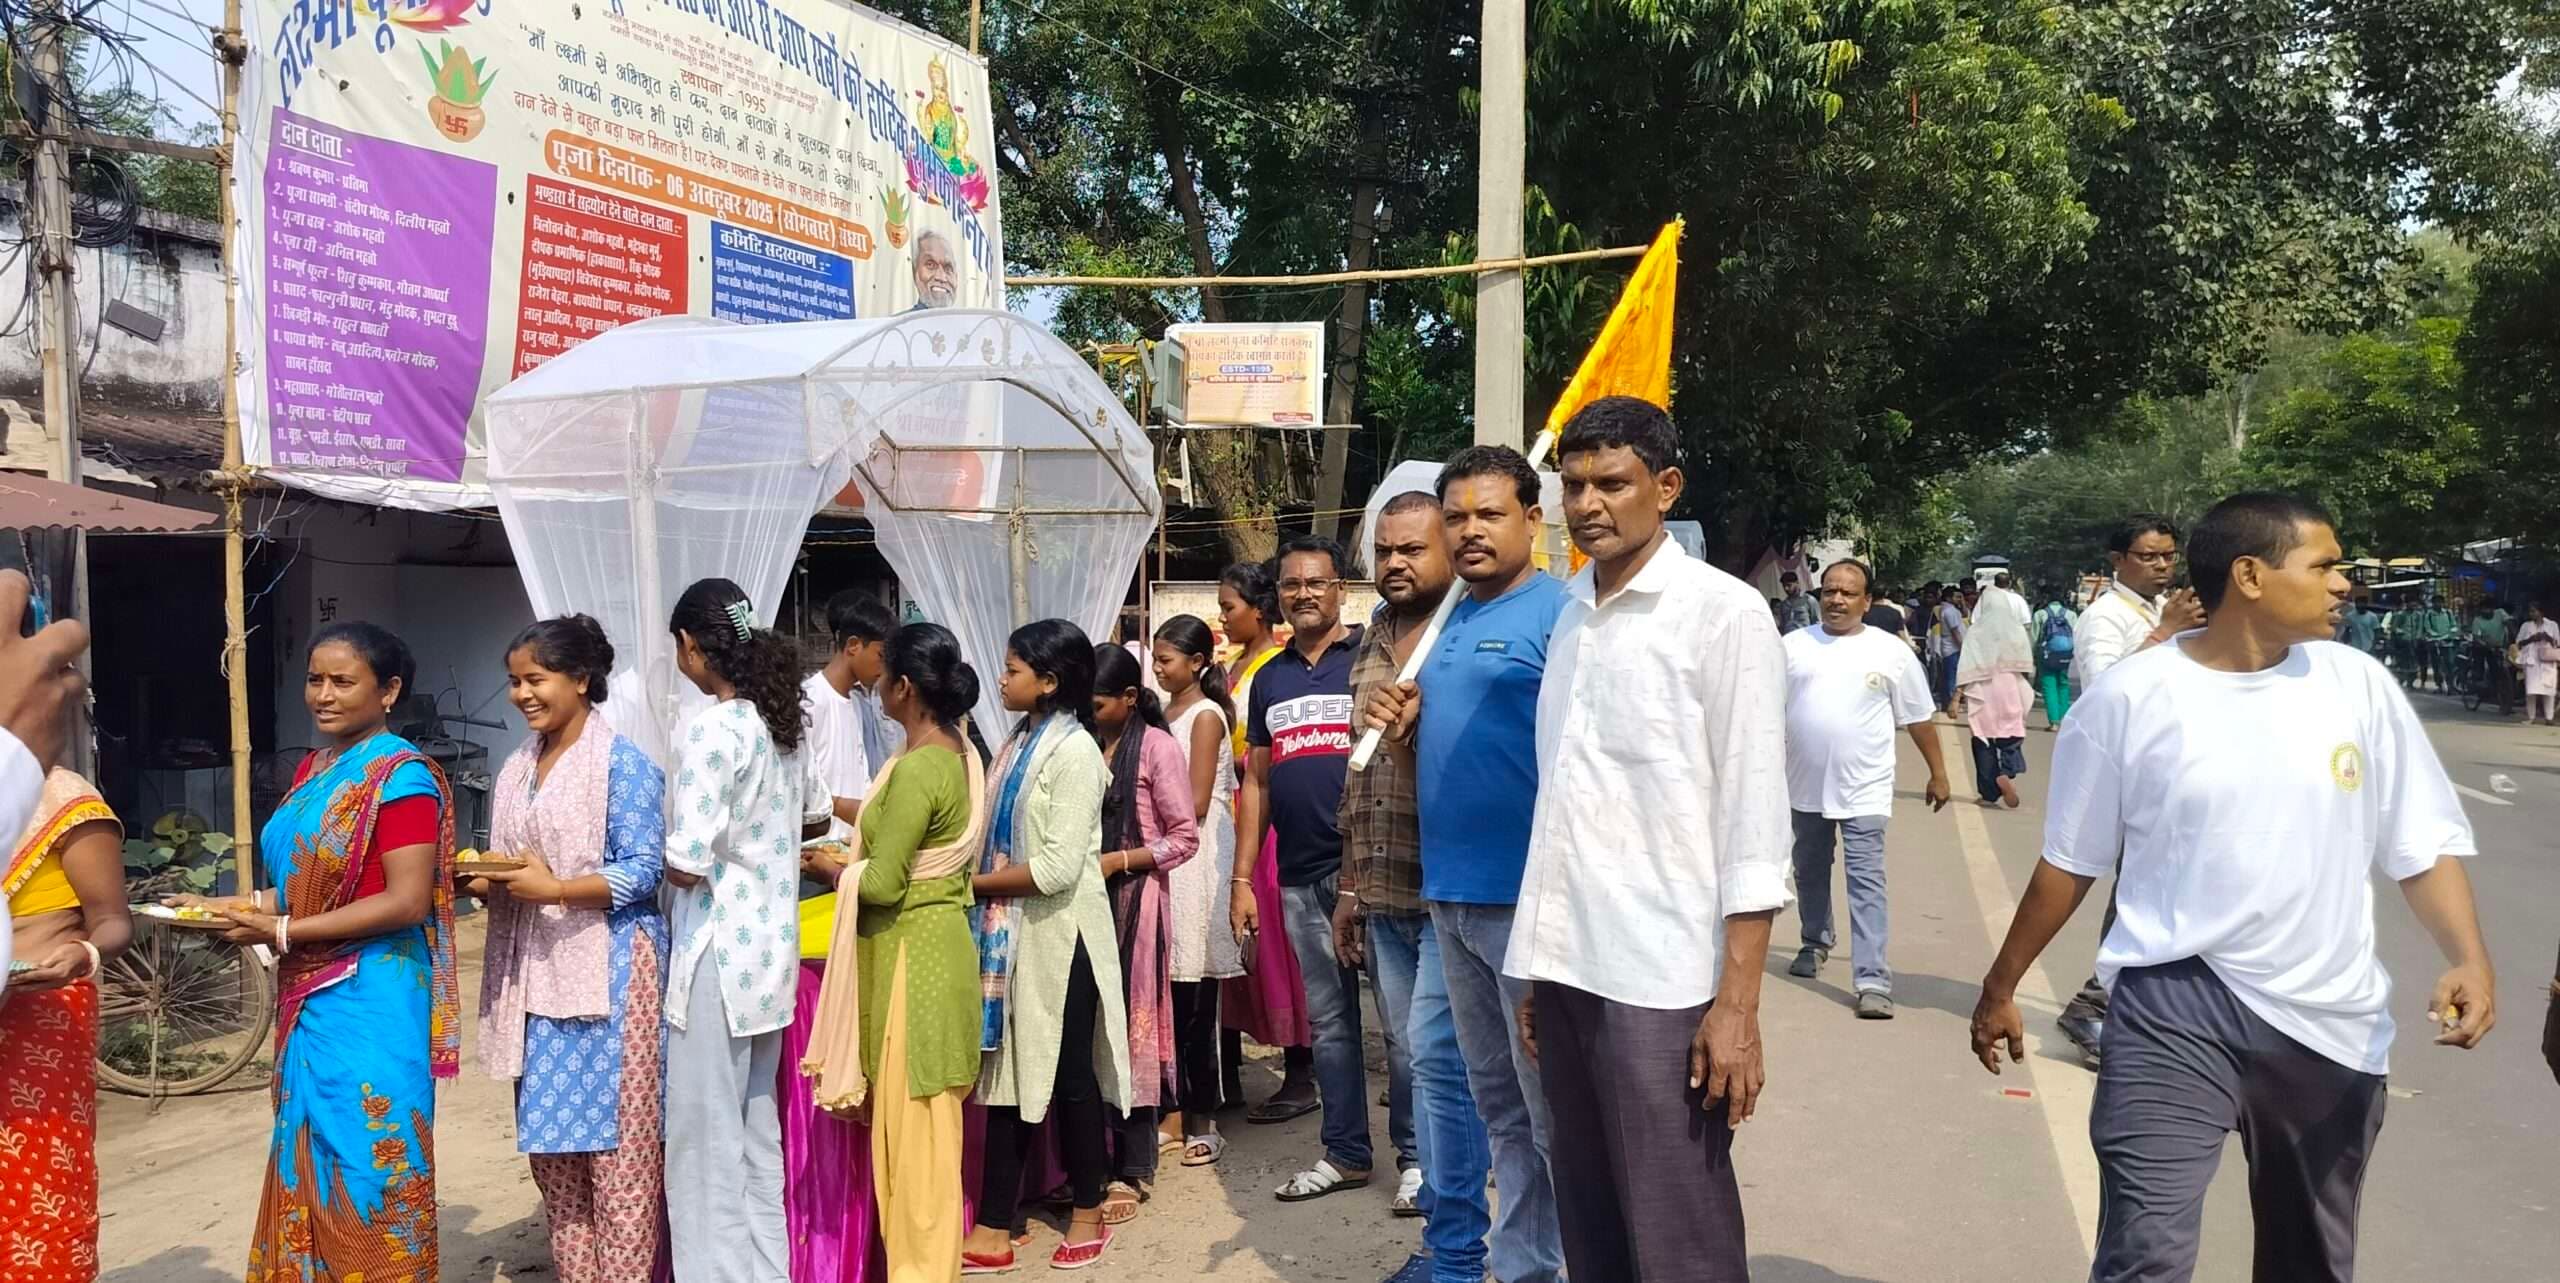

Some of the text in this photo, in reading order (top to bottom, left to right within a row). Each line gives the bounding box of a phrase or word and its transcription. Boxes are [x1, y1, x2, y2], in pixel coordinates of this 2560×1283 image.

[558, 73, 602, 104] आपकी
[609, 92, 643, 119] मुराद
[650, 104, 665, 127] भी
[616, 62, 661, 98] अभिभूत
[669, 80, 681, 102] हो
[680, 68, 723, 96] स्थापना
[738, 90, 766, 114] 1995
[774, 8, 811, 77] आप
[842, 50, 863, 120] को
[864, 78, 908, 161] हार्दिक
[281, 120, 307, 148] दान
[311, 127, 343, 159] दाता
[513, 90, 537, 111] दान
[577, 111, 601, 137] बहुत
[627, 127, 646, 147] फल
[647, 129, 678, 157] मिलता
[694, 149, 708, 168] पर
[276, 157, 286, 172] 1.
[272, 181, 284, 196] 2.
[287, 185, 307, 204] पूजा
[395, 209, 426, 230] दिलीप
[427, 218, 450, 236] महतो
[535, 184, 674, 233] भण्डारा में सहयोग देने वाले दान दाता
[552, 139, 593, 177] पूजा
[666, 173, 685, 199] 06
[688, 180, 742, 220] अक्टूबर
[744, 197, 774, 225] 2025
[777, 202, 836, 248] (सोमवार)
[838, 222, 868, 253] संध्या
[283, 209, 305, 228] पूजा
[362, 227, 385, 244] महतो
[272, 230, 282, 244] 4.
[356, 250, 377, 266] महतो
[272, 254, 282, 269] 5.
[720, 229, 763, 254] कमिटि
[765, 239, 817, 270] सदस्यगण
[333, 316, 359, 336] राहुल
